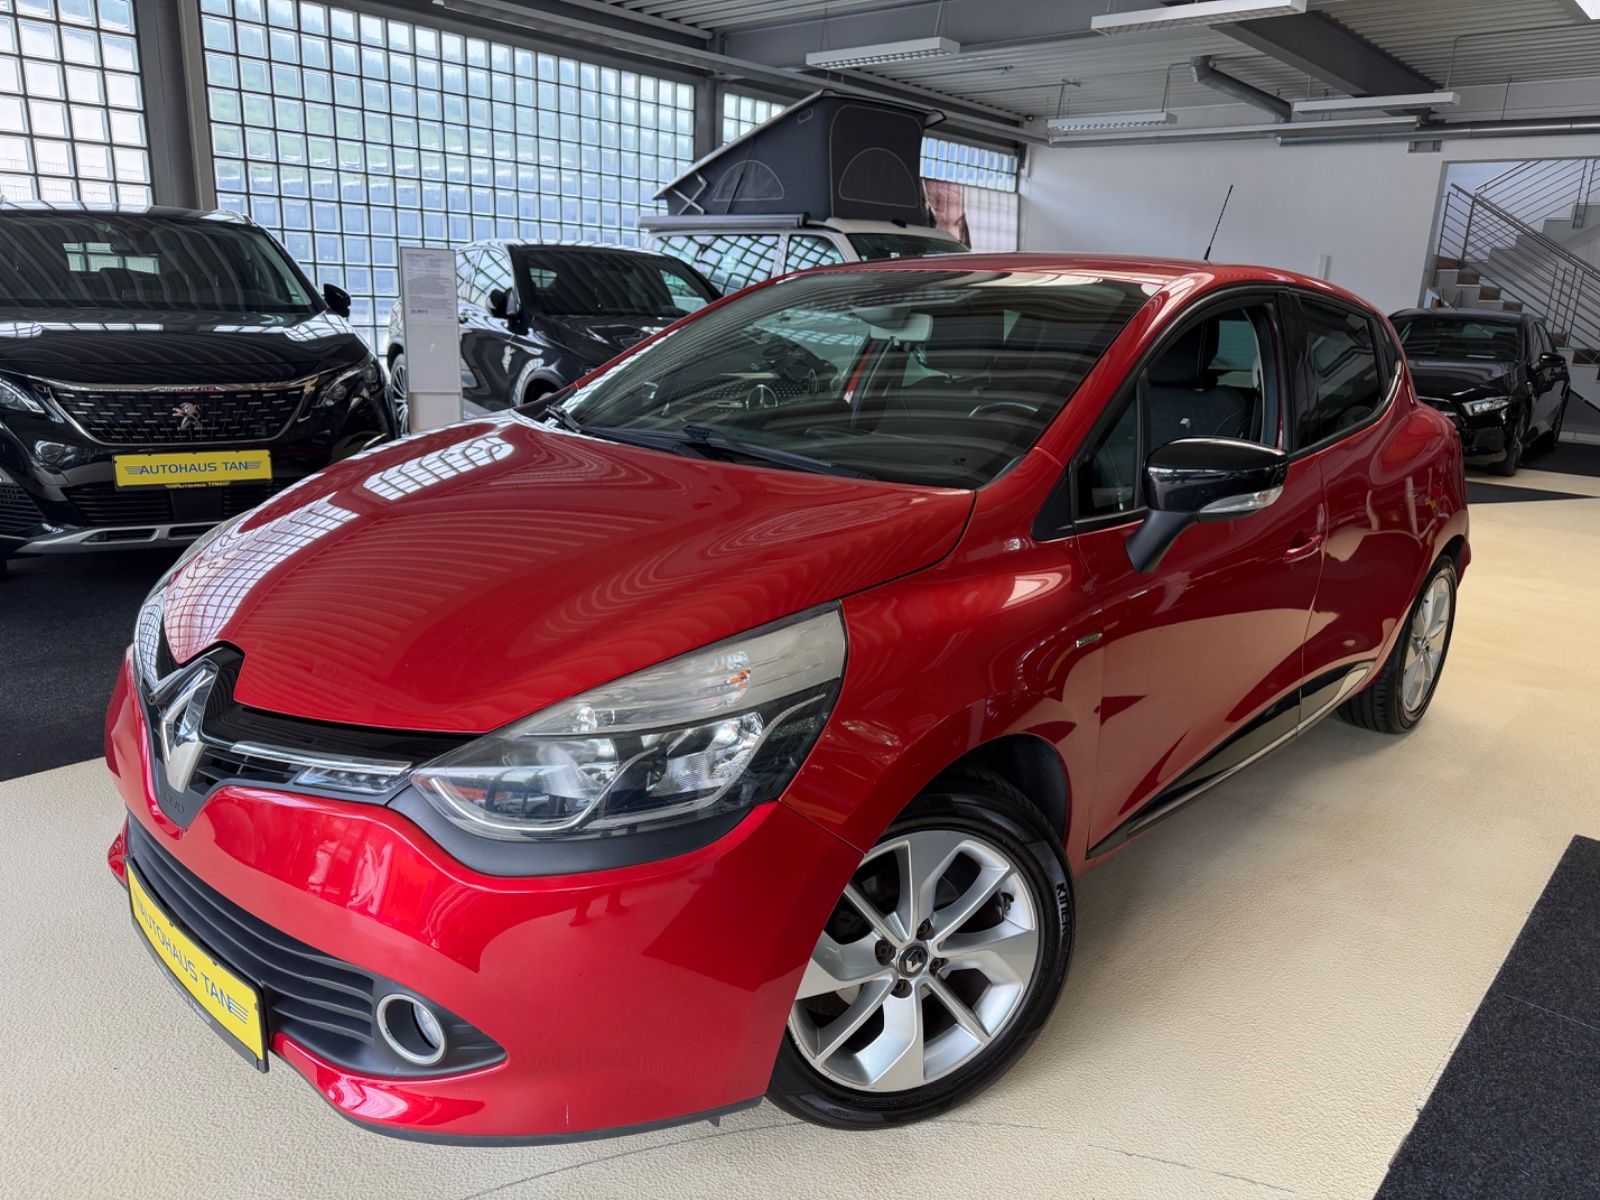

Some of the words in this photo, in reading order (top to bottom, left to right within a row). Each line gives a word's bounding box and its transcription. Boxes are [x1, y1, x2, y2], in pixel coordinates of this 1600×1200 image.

[140, 462, 217, 475] AUTOHAUS
[222, 461, 249, 470] TAN
[139, 905, 198, 981] AUTOHAUS
[200, 972, 233, 1013] TAN
